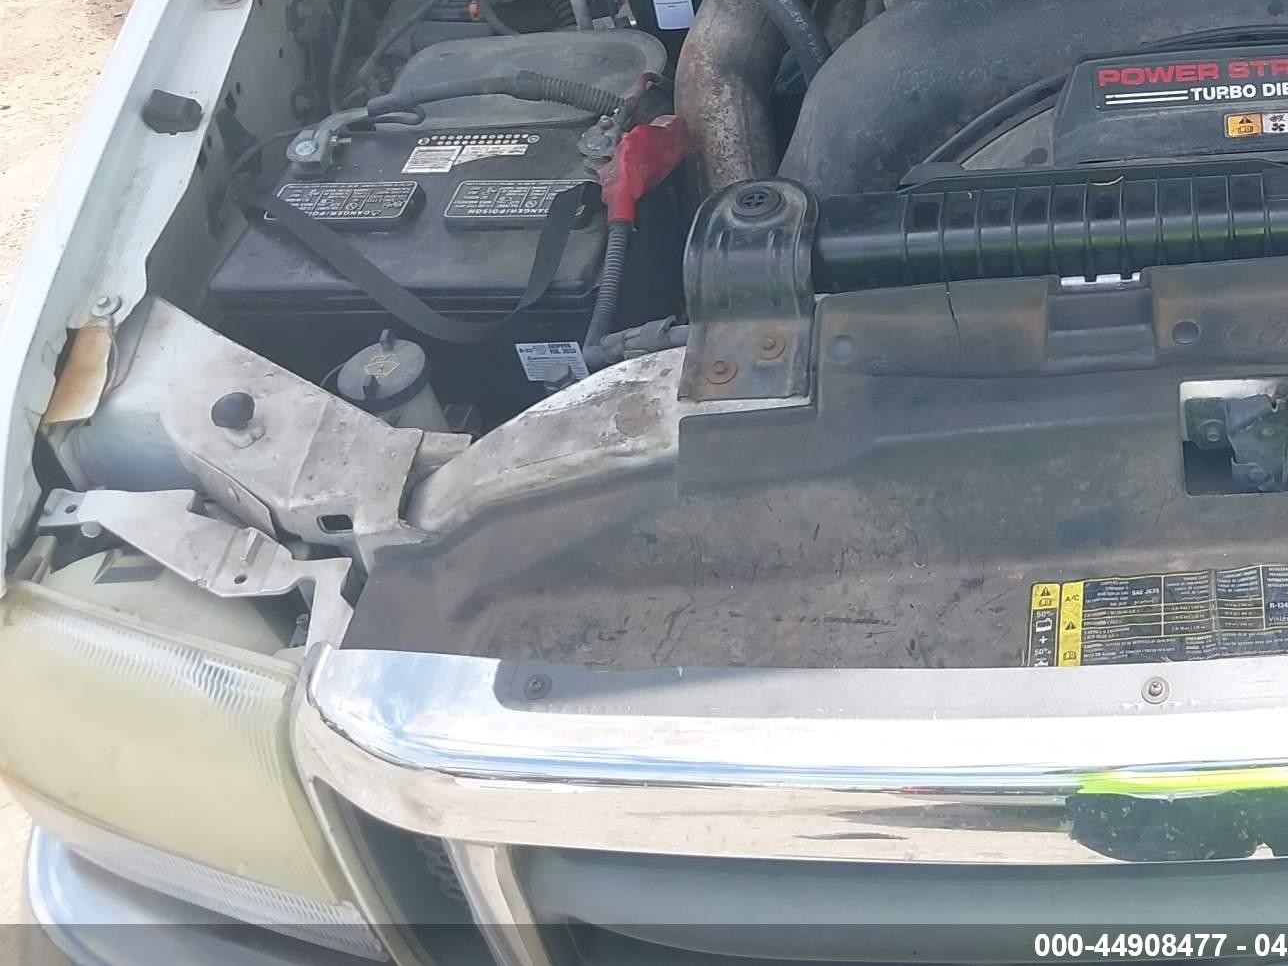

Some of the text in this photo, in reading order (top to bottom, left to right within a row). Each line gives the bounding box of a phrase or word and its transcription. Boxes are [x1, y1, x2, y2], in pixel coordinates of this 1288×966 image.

[1098, 63, 1220, 87] POWER
[1190, 84, 1257, 101] TURBO
[1064, 593, 1080, 603] A/C
